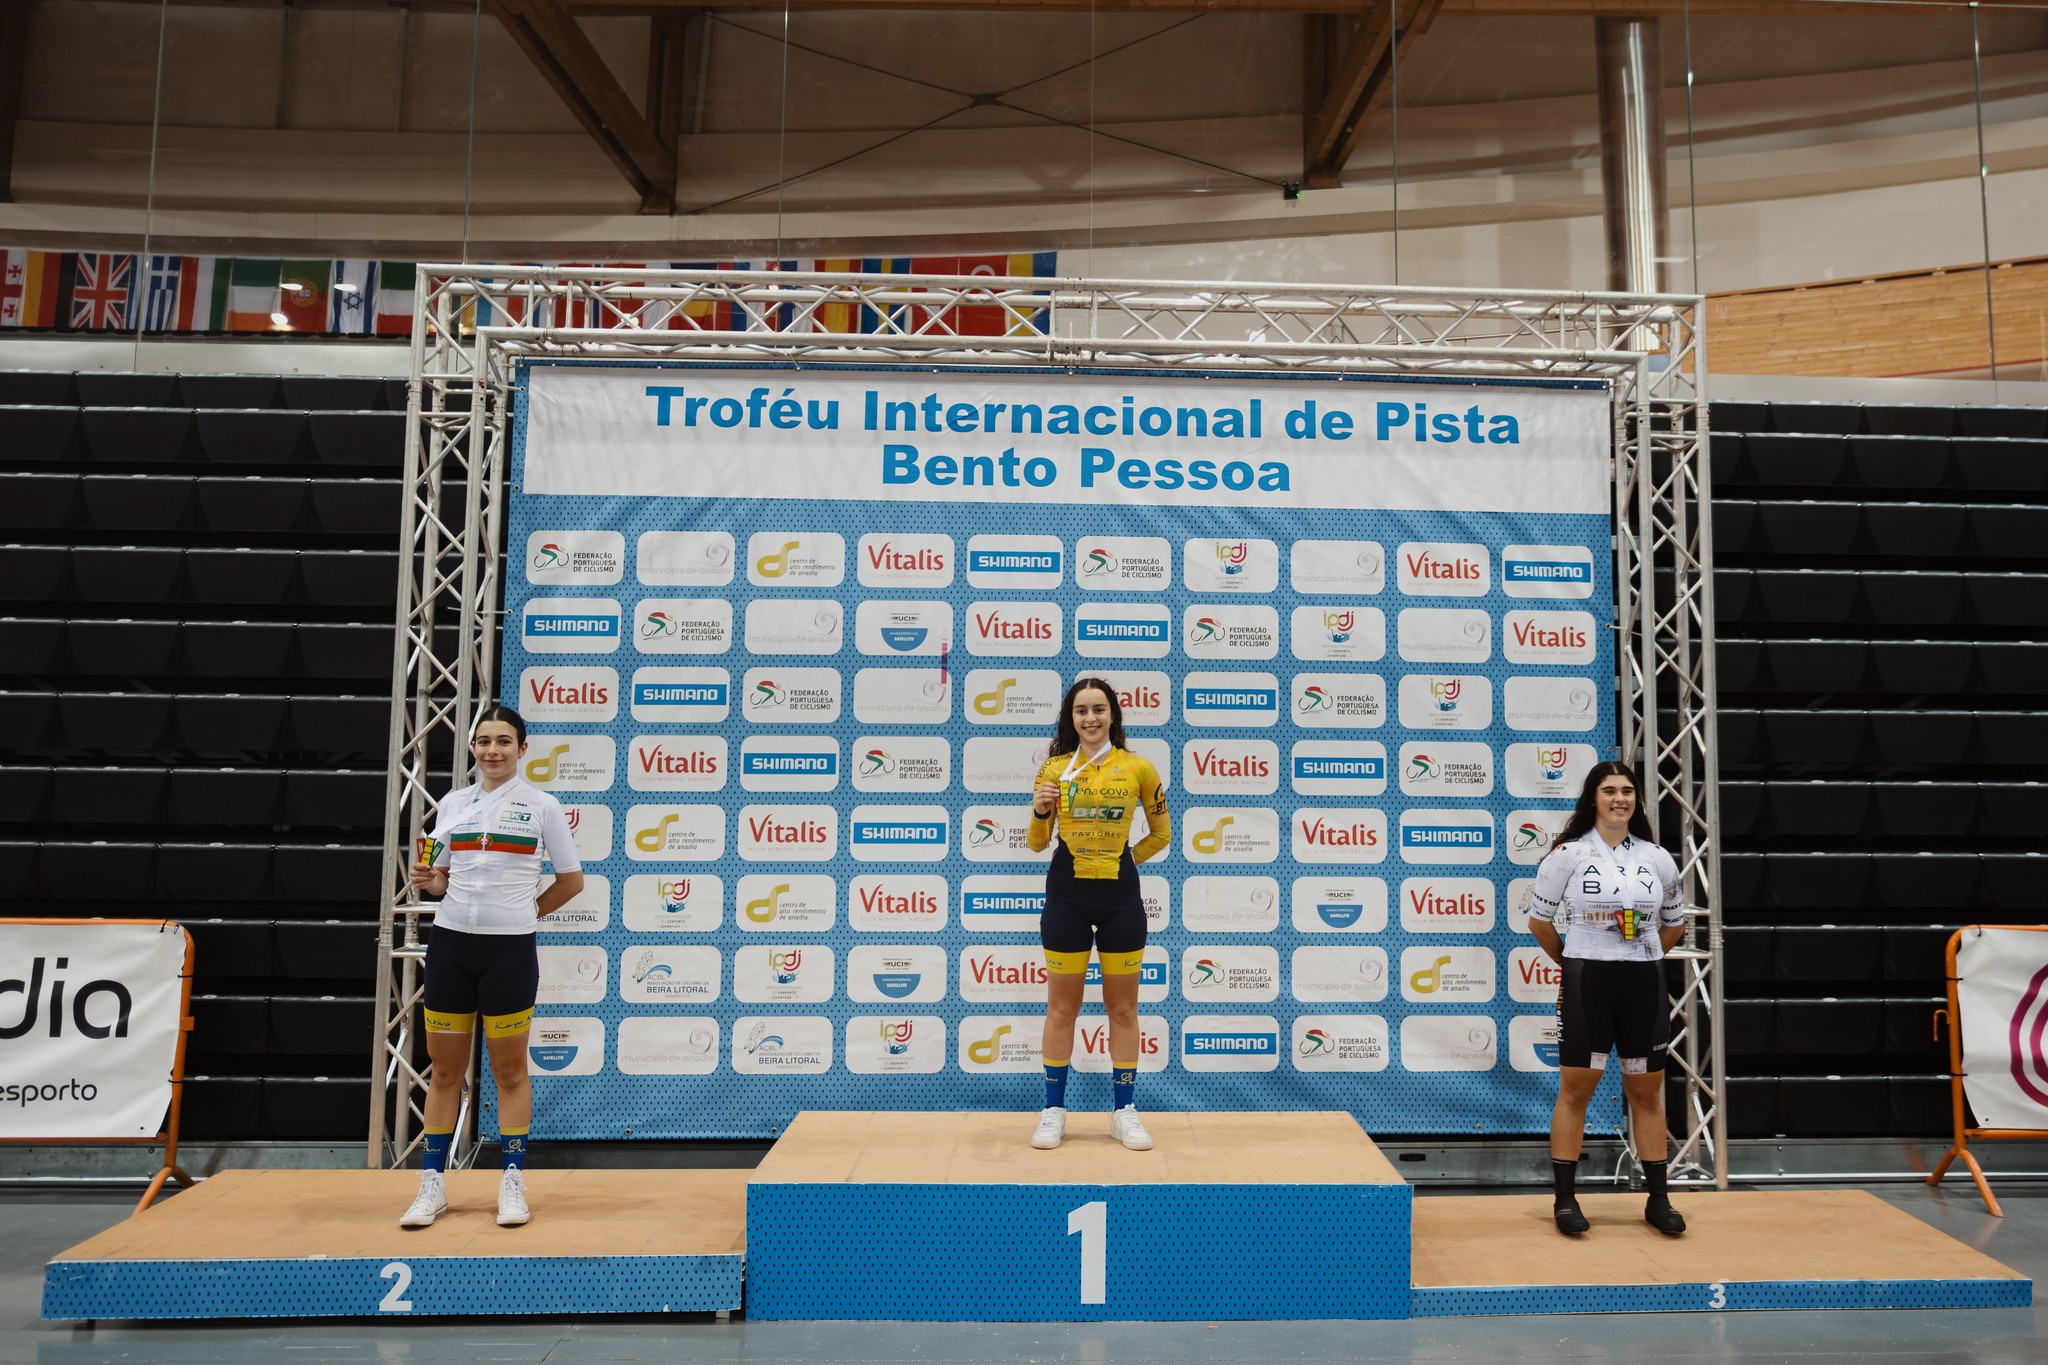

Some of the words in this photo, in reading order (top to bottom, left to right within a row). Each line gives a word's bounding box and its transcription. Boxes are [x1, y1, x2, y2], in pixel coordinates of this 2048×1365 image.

[646, 386, 839, 430] Troféu
[864, 390, 1262, 438] Internacional
[1285, 400, 1354, 440] de
[1376, 402, 1520, 444] Pista
[882, 444, 1057, 487] Bento
[1081, 447, 1291, 491] Pessoa
[574, 552, 612, 560] FEDERAÇÃO
[868, 542, 944, 570] Vitalis
[979, 556, 1052, 568] SHIMANO
[1122, 558, 1159, 566] FEDERAÇÃO
[1406, 551, 1480, 579] Vitalis
[1513, 566, 1583, 578] SHIMANO
[534, 620, 609, 632] SHIMANO
[682, 620, 720, 628] FEDERAÇÃO
[976, 610, 1052, 639] Vitalis
[1087, 625, 1159, 636] SHIMANO
[1229, 626, 1267, 634] FEDERAÇÃO
[1513, 619, 1586, 647] Vitalis
[530, 675, 608, 705] Vitalis
[643, 688, 718, 701] SHIMANO
[790, 689, 828, 697] FEDERAÇÃO
[1195, 693, 1267, 705] SHIMANO
[1337, 695, 1374, 703] FEDERAÇÃO
[639, 744, 717, 774] Vitalis
[752, 757, 827, 770] SHIMANO
[899, 758, 938, 766] FEDERAÇÃO
[1193, 748, 1268, 777] Vitalis
[1303, 762, 1375, 774] SHIMANO
[1444, 763, 1481, 771] FEDERAÇÃO
[749, 813, 826, 843] Vitalis
[862, 827, 937, 839] SHIMANO
[1302, 817, 1377, 846] Vitalis
[1411, 831, 1483, 843] SHIMANO
[859, 884, 937, 914] Vitalis
[973, 897, 1046, 909] SHIMANO
[1410, 886, 1485, 915] Vitalis
[970, 954, 1047, 984] Vitalis
[1229, 968, 1267, 976] FEDERAÇÃO
[1194, 1037, 1268, 1050] SHIMANO
[1339, 1037, 1377, 1046] FEDERAÇÃO
[1068, 1202, 1106, 1304] 1
[379, 1262, 412, 1311] 2
[1708, 1283, 1726, 1308] 3
